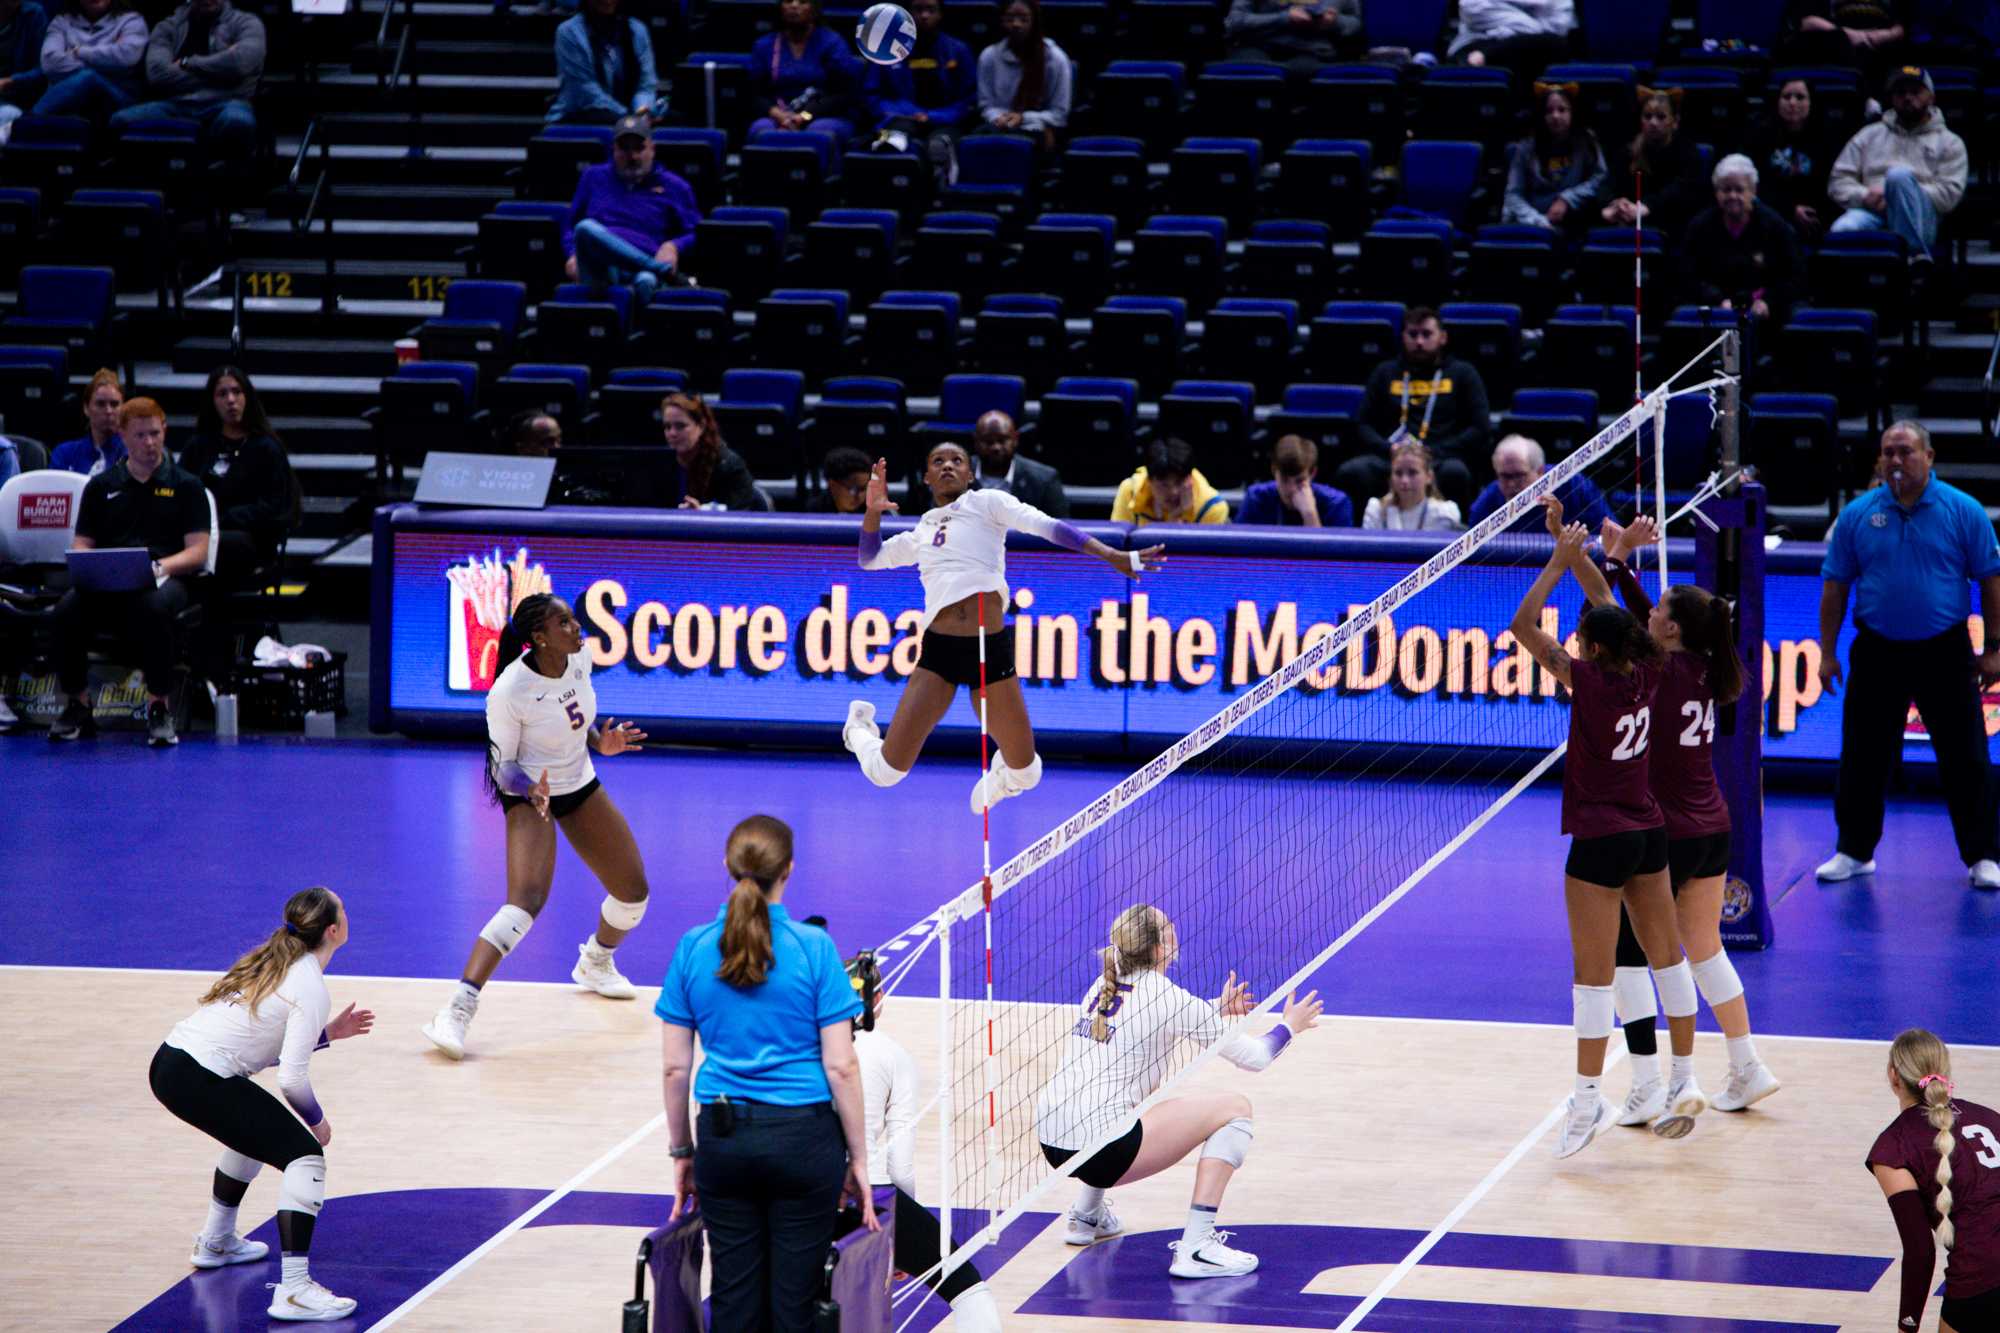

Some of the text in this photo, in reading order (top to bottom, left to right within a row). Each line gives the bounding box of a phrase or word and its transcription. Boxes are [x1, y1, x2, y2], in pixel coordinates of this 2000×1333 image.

[246, 272, 292, 297] 112
[479, 479, 533, 490] REVIEW
[482, 469, 535, 480] VIDEO
[37, 497, 66, 507] FARM
[154, 487, 175, 498] LSU
[23, 506, 66, 518] BUREAU
[931, 524, 947, 548] 6
[584, 579, 787, 672] Score
[804, 585, 926, 676] dea
[1014, 588, 1079, 680] in
[1095, 593, 1218, 685] the
[1332, 607, 1372, 650] GEAUX TIGERS
[1282, 643, 1324, 686] GEAUX TIGERS
[558, 688, 576, 704] LSU
[1231, 679, 1274, 724] GEAUX TIGERS
[564, 700, 585, 732] 5
[1679, 698, 1715, 746] 24
[1177, 716, 1222, 762] GEAUX TIGERS
[1611, 706, 1650, 760] 22
[1121, 755, 1168, 801] GEAUX TIGERS
[1002, 854, 1027, 886] GEAUX
[1961, 1123, 2000, 1169] 3
